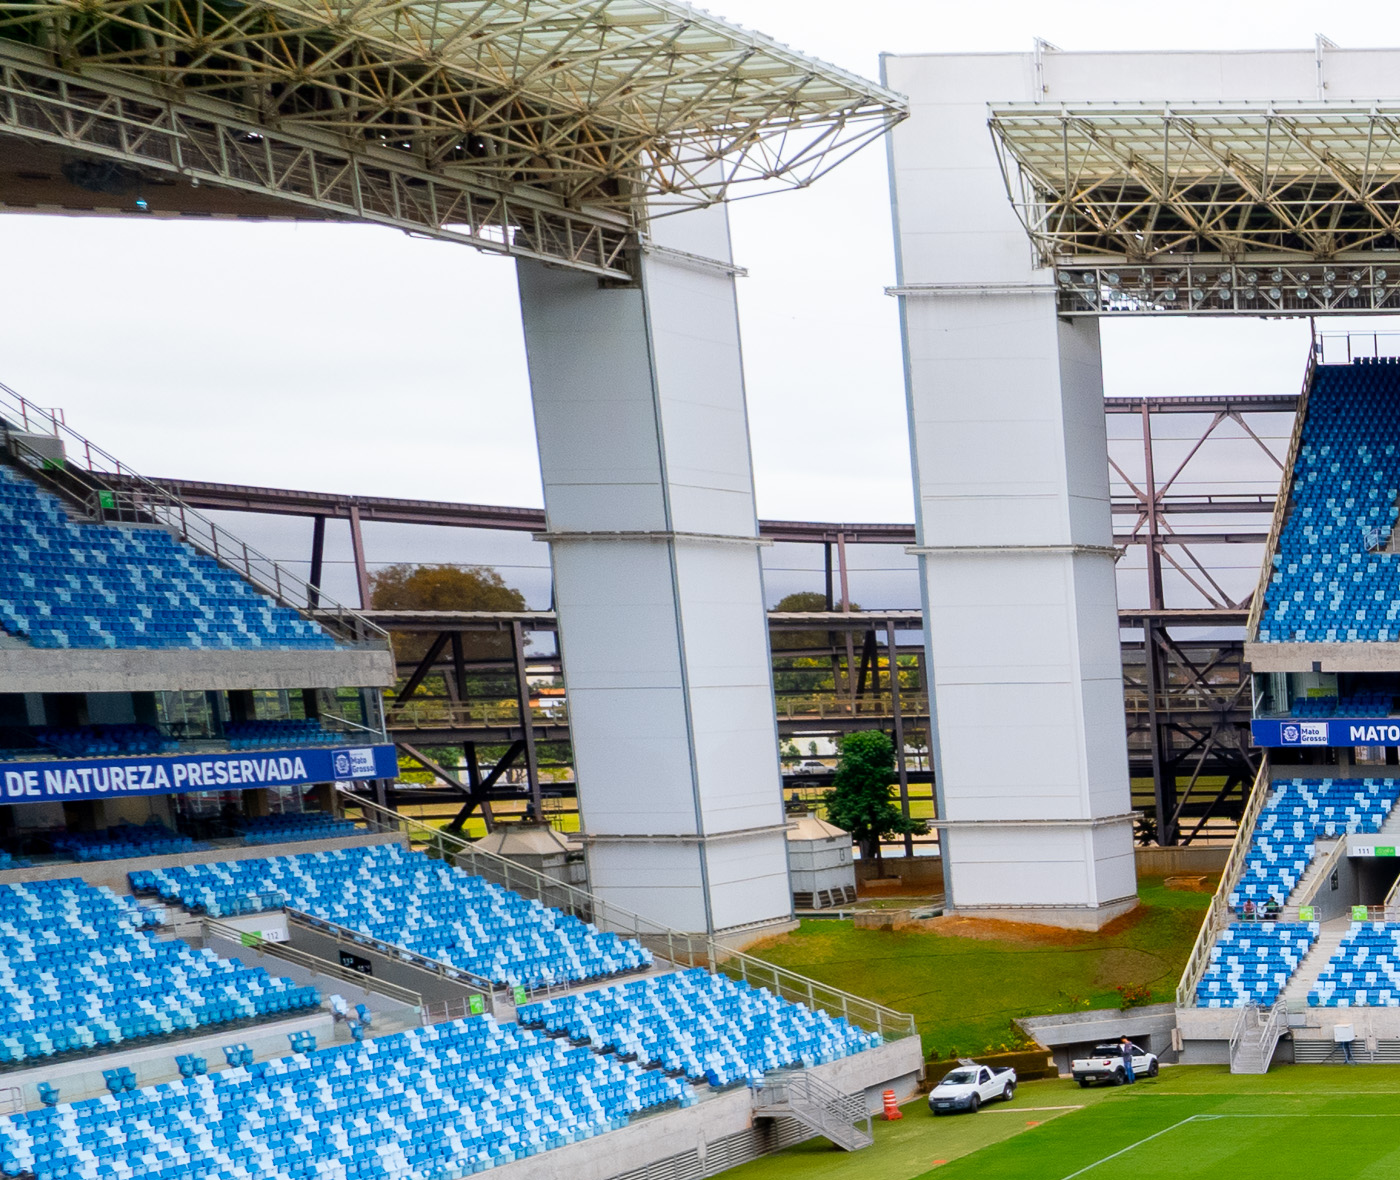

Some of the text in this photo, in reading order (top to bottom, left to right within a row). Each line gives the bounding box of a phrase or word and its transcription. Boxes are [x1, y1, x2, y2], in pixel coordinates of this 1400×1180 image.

[1350, 725, 1400, 741] MATO
[351, 756, 367, 765] Mato
[351, 764, 374, 773] Grosso
[4, 756, 308, 797] DE NATUREZA PRESERVADA
[266, 931, 279, 940] 112
